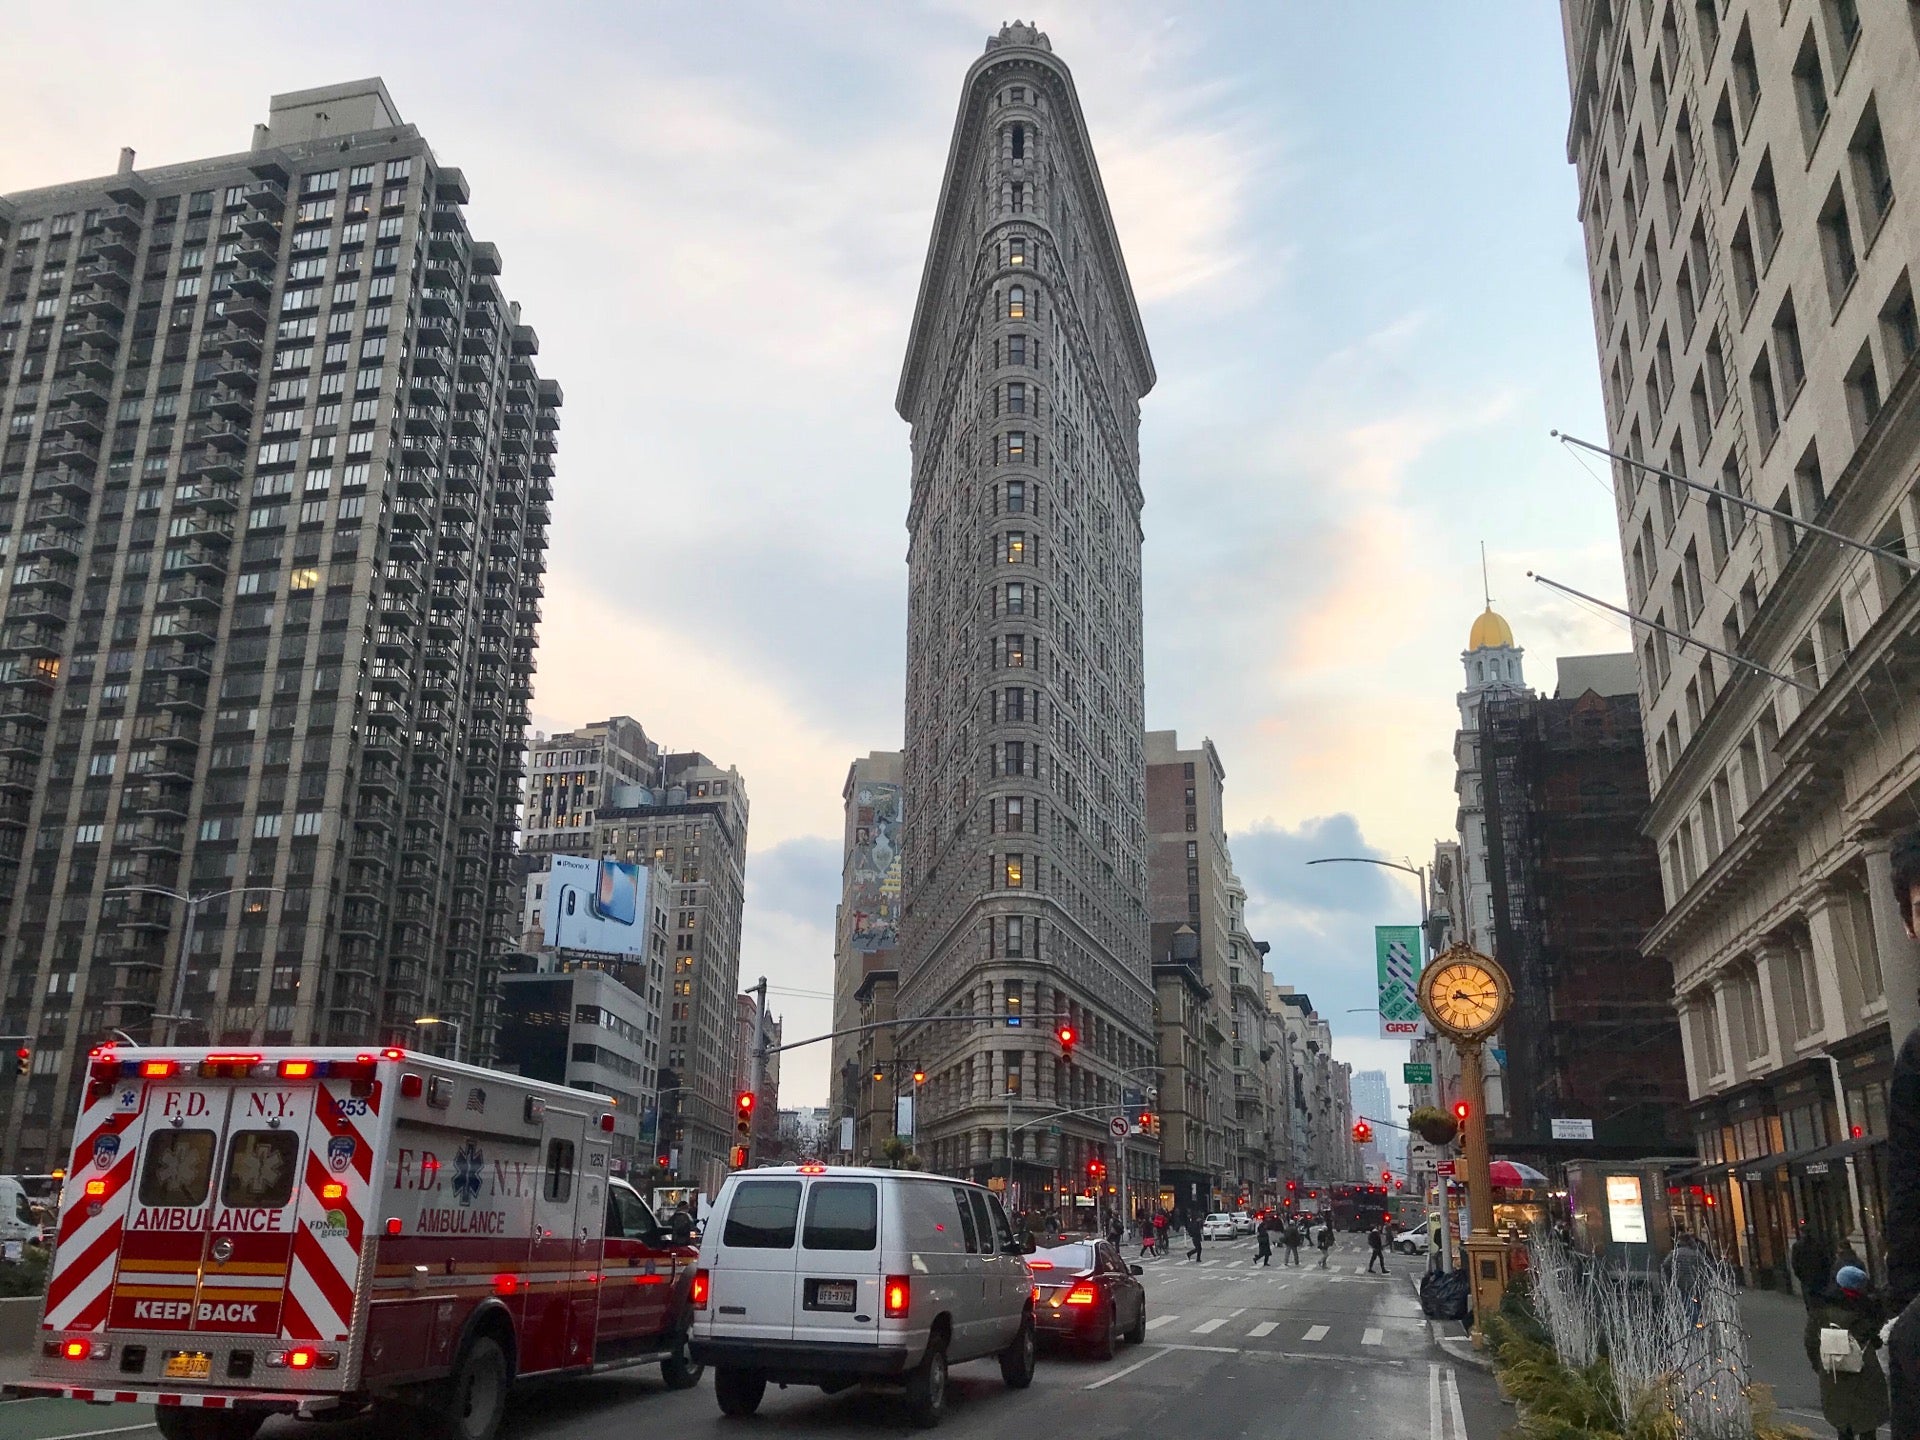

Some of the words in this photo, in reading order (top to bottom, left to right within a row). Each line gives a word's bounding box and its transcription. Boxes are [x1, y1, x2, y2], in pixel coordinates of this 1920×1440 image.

[562, 861, 584, 870] iPhone
[1385, 1023, 1418, 1033] GREY
[163, 1092, 210, 1116] F.D.
[246, 1093, 294, 1117] N.Y.
[133, 1208, 282, 1231] AMBULANCE
[310, 1220, 335, 1230] FDNY
[416, 1208, 506, 1234] AMBULANCE
[321, 1229, 348, 1239] green
[134, 1301, 191, 1320] KEEP
[198, 1303, 258, 1322] BACK
